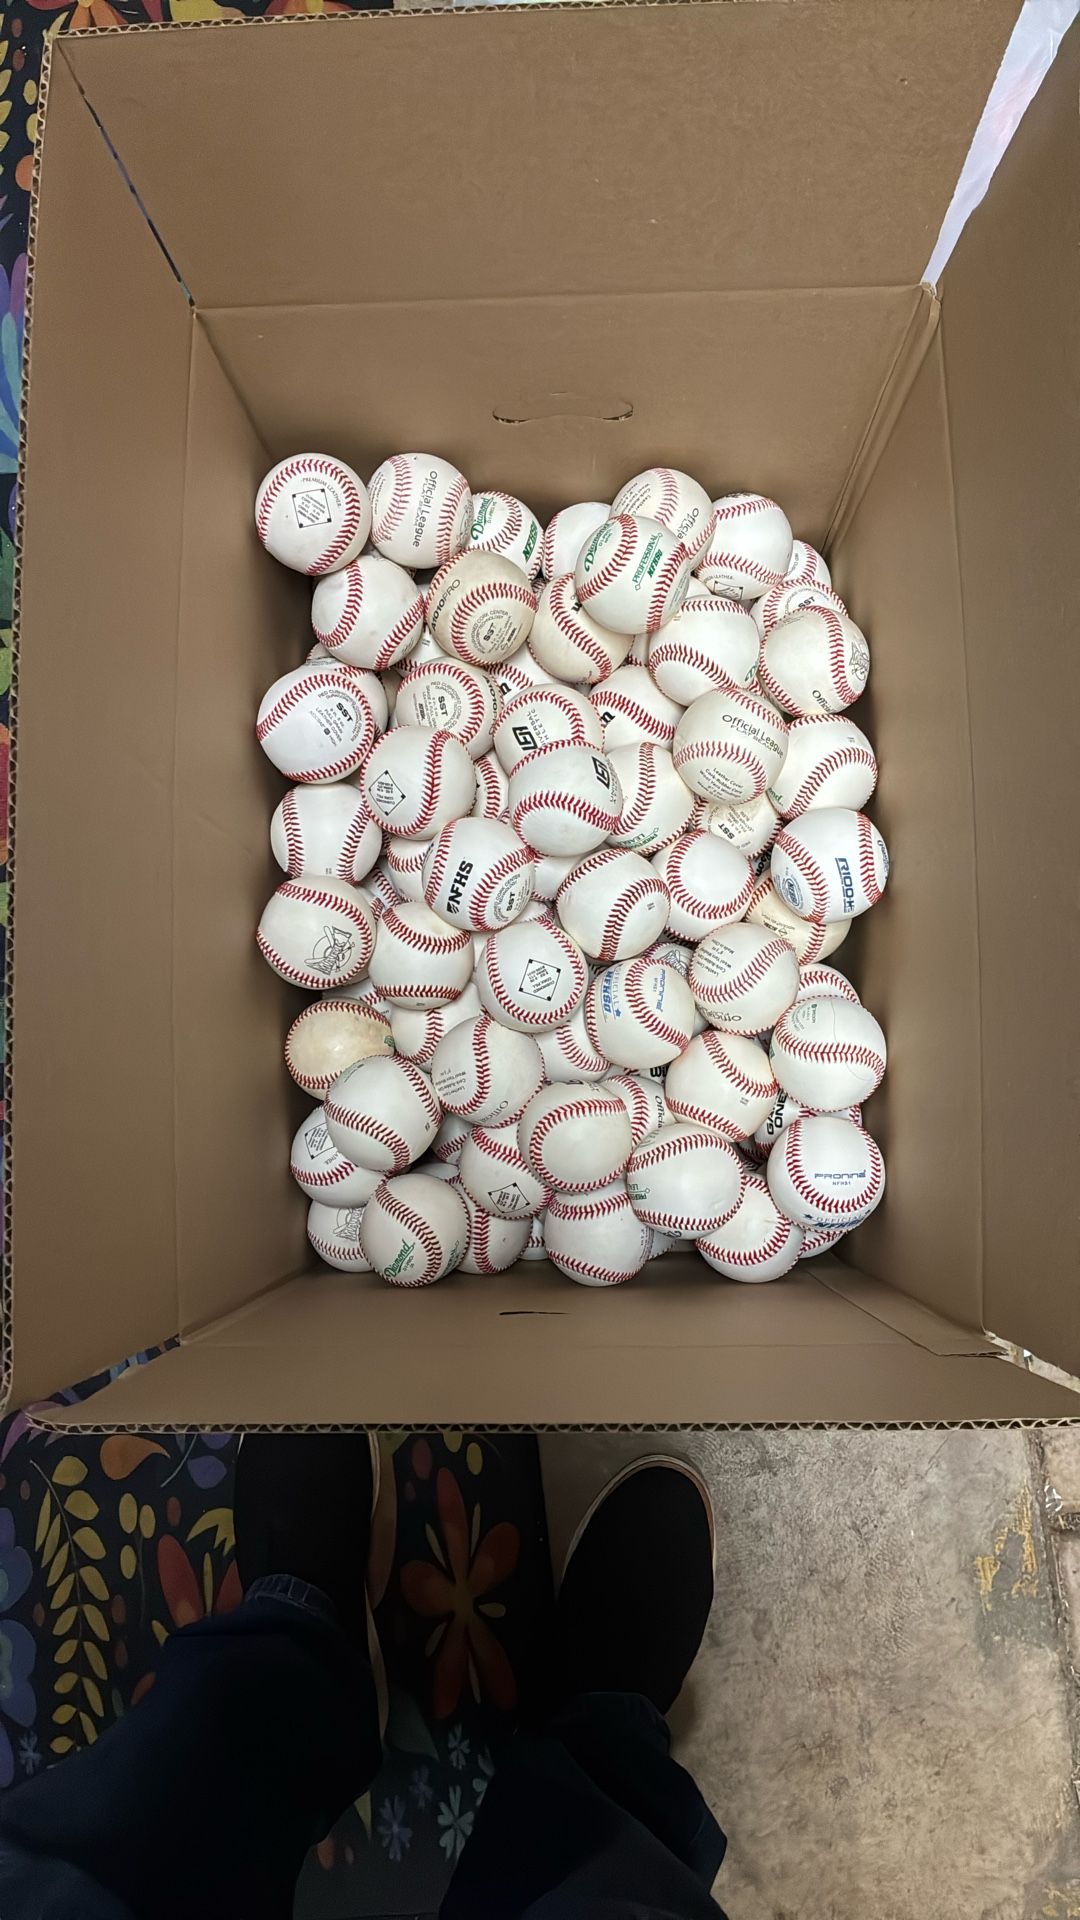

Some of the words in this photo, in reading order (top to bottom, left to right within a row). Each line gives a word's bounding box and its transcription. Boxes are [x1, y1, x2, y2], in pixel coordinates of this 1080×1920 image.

[301, 476, 326, 486] PREMIUM
[326, 484, 341, 506] LEATHER
[421, 470, 437, 507] Official
[412, 509, 431, 547] League
[469, 496, 492, 542] Diamond
[676, 507, 700, 540] Officia
[581, 522, 610, 572] Diamond
[631, 534, 658, 582] PROFESSIONAL
[798, 595, 815, 609] SST
[482, 622, 496, 641] SST
[323, 708, 333, 719] FULL
[335, 701, 353, 723] SST
[437, 695, 448, 716] SST
[315, 707, 332, 726] LEATHER
[330, 726, 343, 742] COVER
[531, 708, 549, 740] HLETIC
[721, 711, 760, 736] Official
[759, 730, 786, 758] League
[713, 767, 730, 782] Leather
[729, 780, 743, 788] Cover
[717, 822, 734, 839] SST
[448, 859, 473, 904] NFHS
[506, 891, 515, 911] SST
[719, 959, 731, 968] Wool
[722, 945, 734, 954] Made
[704, 965, 719, 976] Leather
[656, 968, 665, 1011] PRONINE
[455, 1070, 465, 1078] Wool
[654, 1096, 662, 1128] Officia
[774, 1093, 786, 1127] ONE
[325, 1153, 338, 1164] ATHER
[383, 1239, 414, 1275] Diamond
